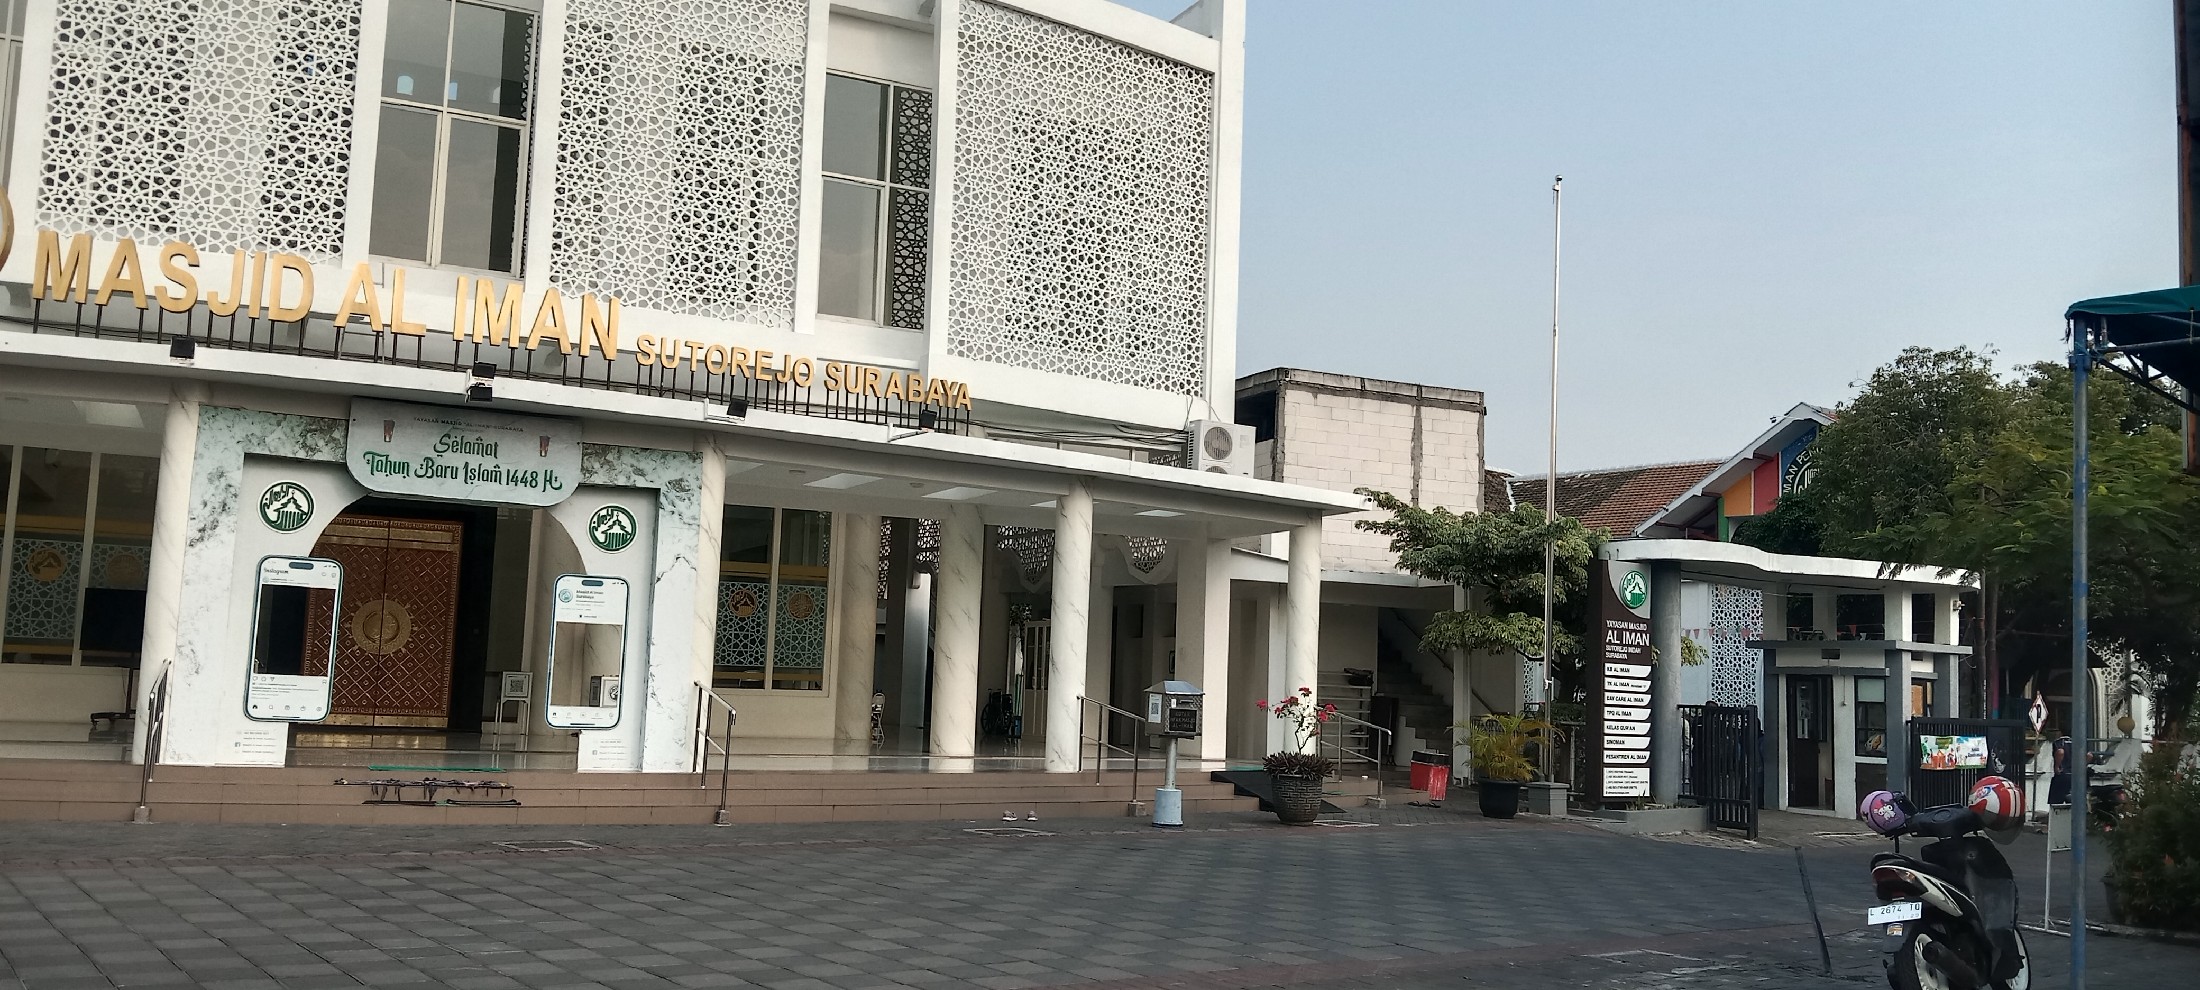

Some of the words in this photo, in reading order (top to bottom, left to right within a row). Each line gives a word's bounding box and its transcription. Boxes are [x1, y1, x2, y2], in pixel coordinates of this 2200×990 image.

[32, 230, 315, 323] MASJID
[333, 262, 427, 336] AL
[453, 276, 620, 361] IMAN
[636, 334, 815, 388] SUTOREJO
[824, 360, 973, 411] SURABAYA
[433, 433, 498, 459] Selamat
[363, 450, 410, 479] Tahun
[414, 457, 459, 480] Baru
[463, 462, 502, 485] Islam
[506, 469, 538, 488] 1448
[542, 469, 563, 492] H
[1783, 464, 1798, 493] MAN
[264, 567, 289, 575] Instagram
[1606, 620, 1628, 629] YAYASAN
[1629, 622, 1647, 631] MASJID
[1606, 630, 1620, 644] AL
[1623, 631, 1650, 647] IMAN
[1605, 645, 1628, 653] SUTOREJO
[1605, 652, 1628, 660] SURABAYA
[1880, 905, 1902, 915] 2674
